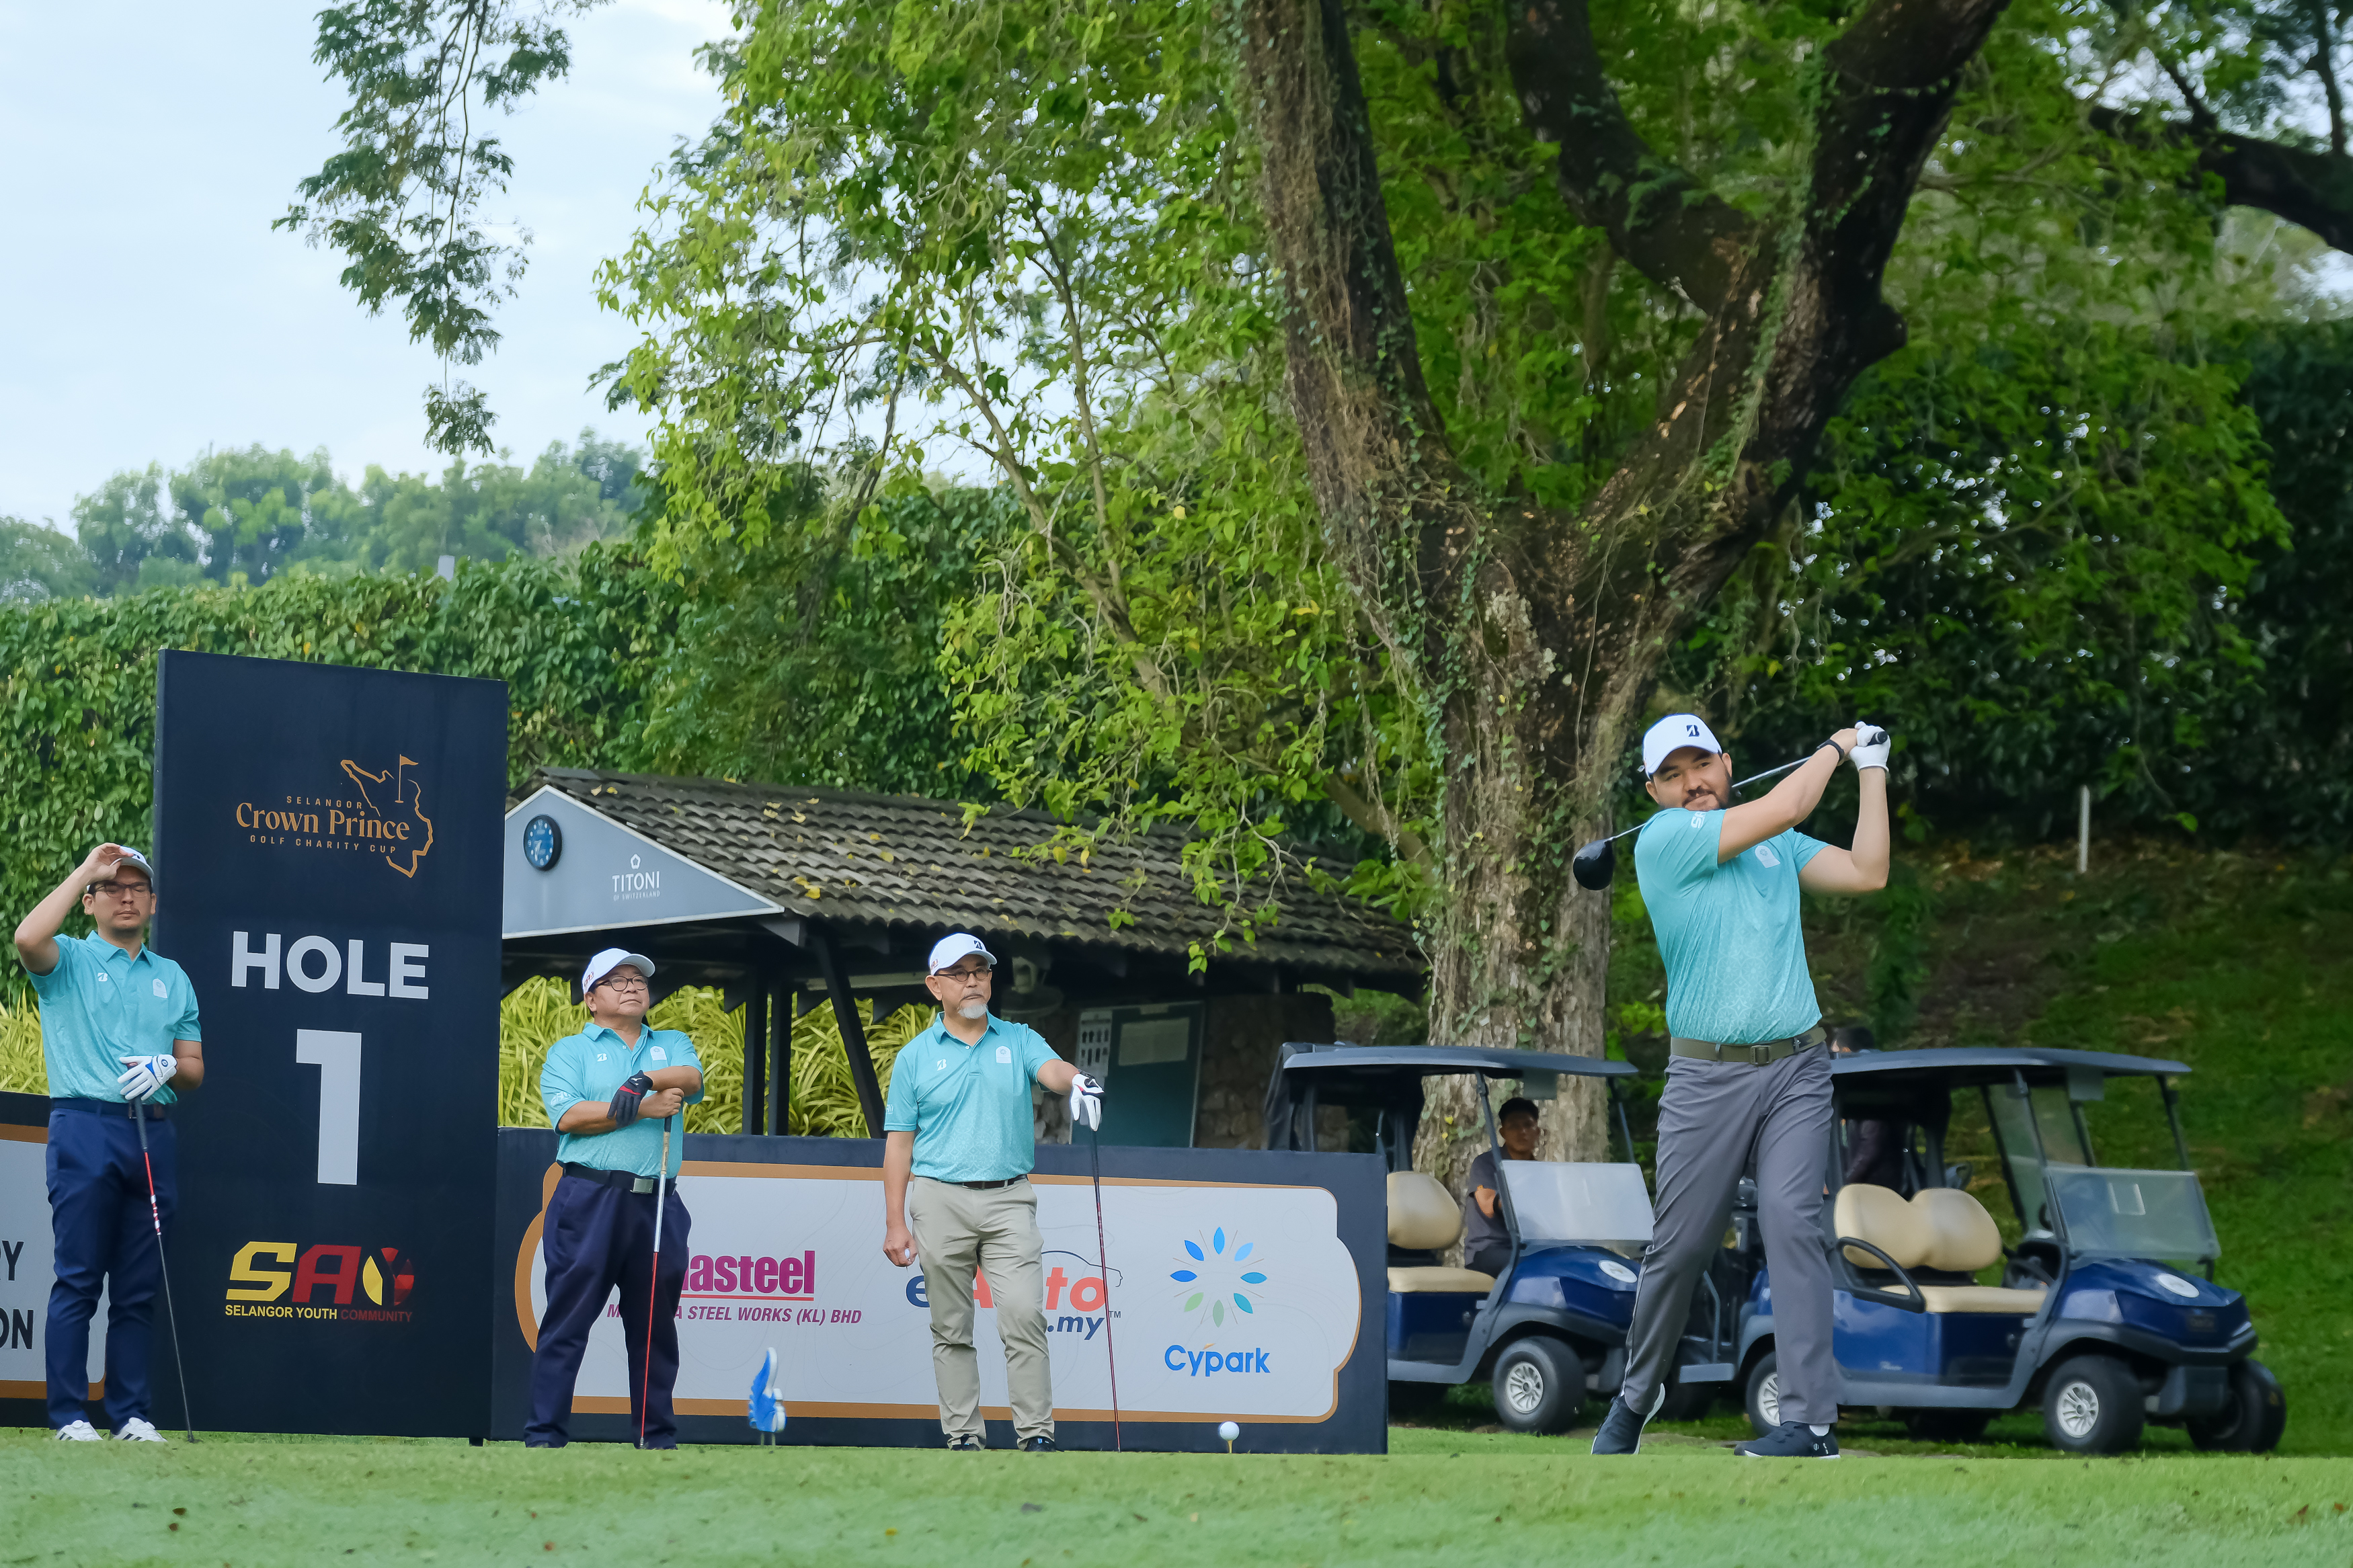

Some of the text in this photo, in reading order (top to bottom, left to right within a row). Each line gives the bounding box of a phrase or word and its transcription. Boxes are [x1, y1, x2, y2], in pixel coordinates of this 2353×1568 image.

[287, 796, 362, 809] SELANGOR
[237, 802, 409, 840] Crown Prince
[250, 835, 396, 853] GOLF CHARITY CUP
[612, 870, 660, 893] TITONI
[231, 931, 429, 999] HOLE
[296, 1029, 362, 1185] 1
[682, 1247, 815, 1294] asteel
[225, 1305, 412, 1322] SELANGOR YOUTH COMMUNITY
[688, 1306, 732, 1321] STEEL
[738, 1307, 791, 1322] WORKS
[796, 1308, 826, 1326] (KL)
[830, 1310, 862, 1324] BHD
[1164, 1345, 1271, 1377] Cypark
